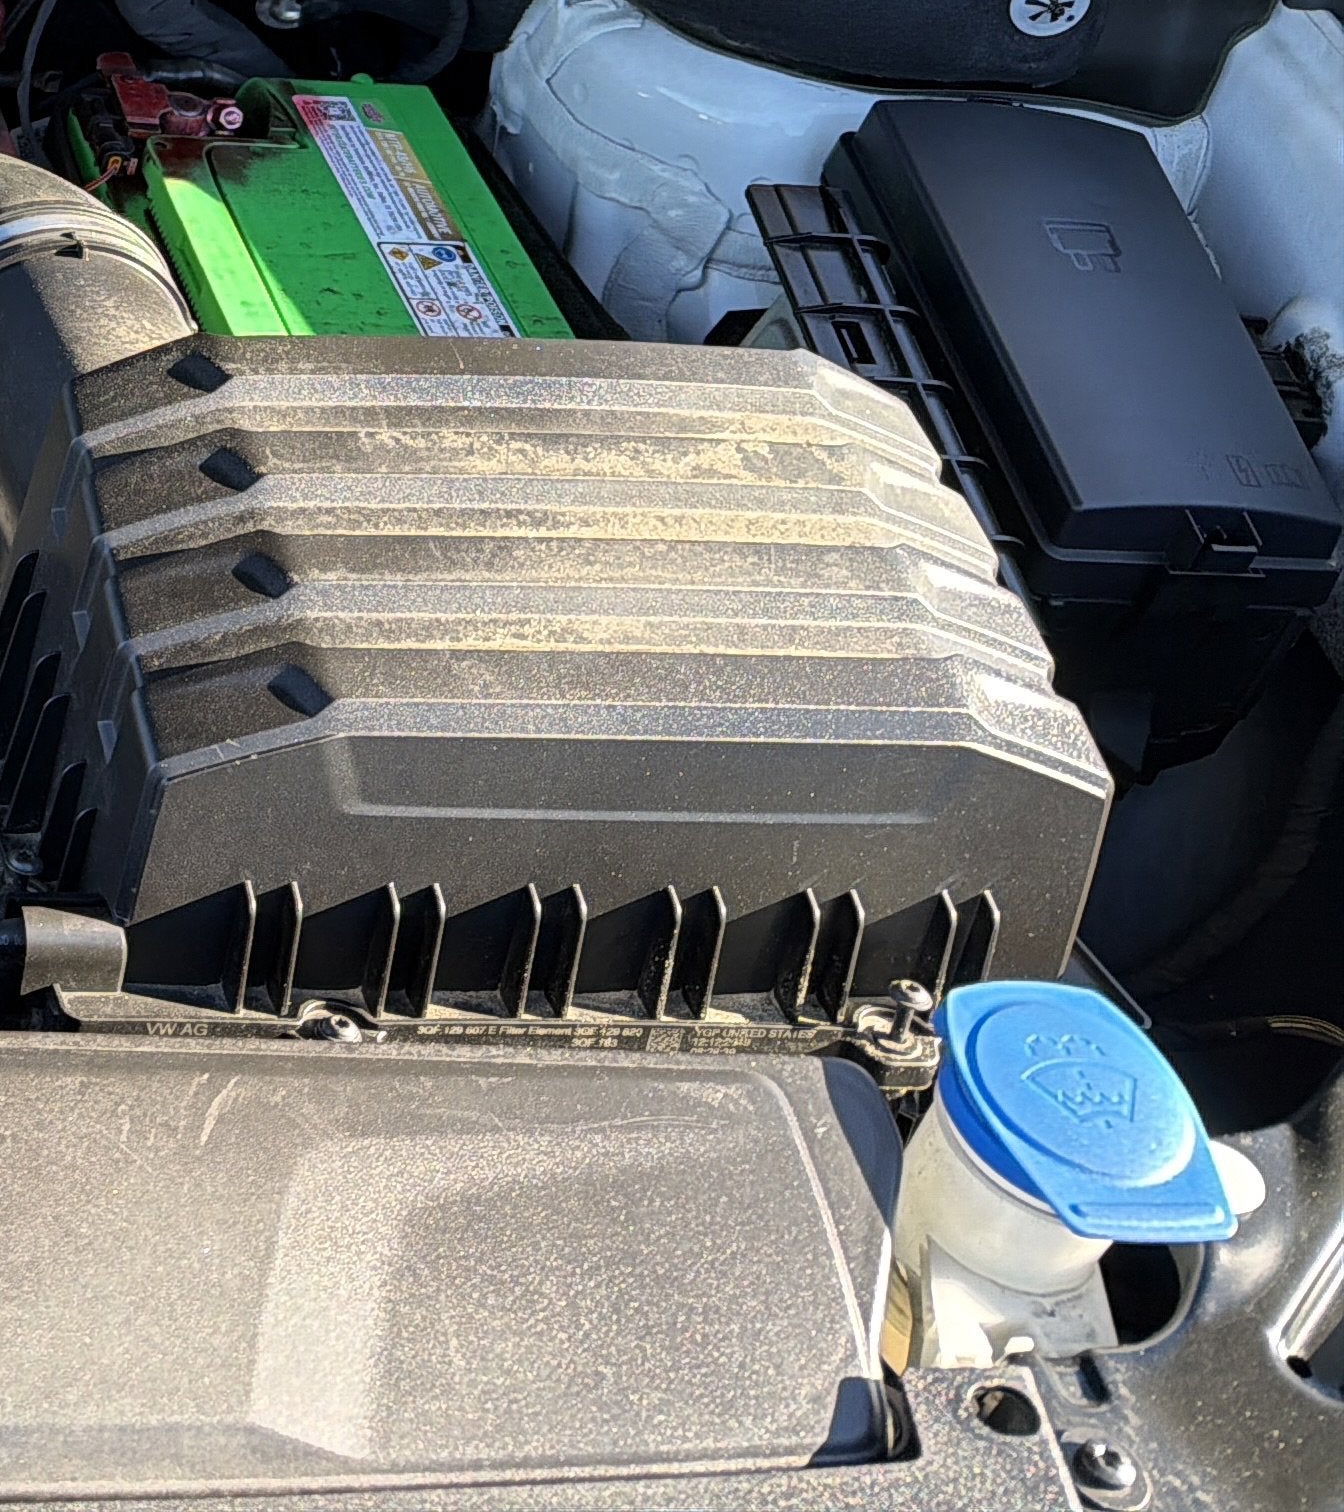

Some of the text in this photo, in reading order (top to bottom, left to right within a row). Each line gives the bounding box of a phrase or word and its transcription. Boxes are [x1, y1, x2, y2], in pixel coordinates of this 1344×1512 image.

[146, 1022, 209, 1037] VW AG
[499, 1025, 527, 1036] Filter
[528, 1025, 572, 1036] Element
